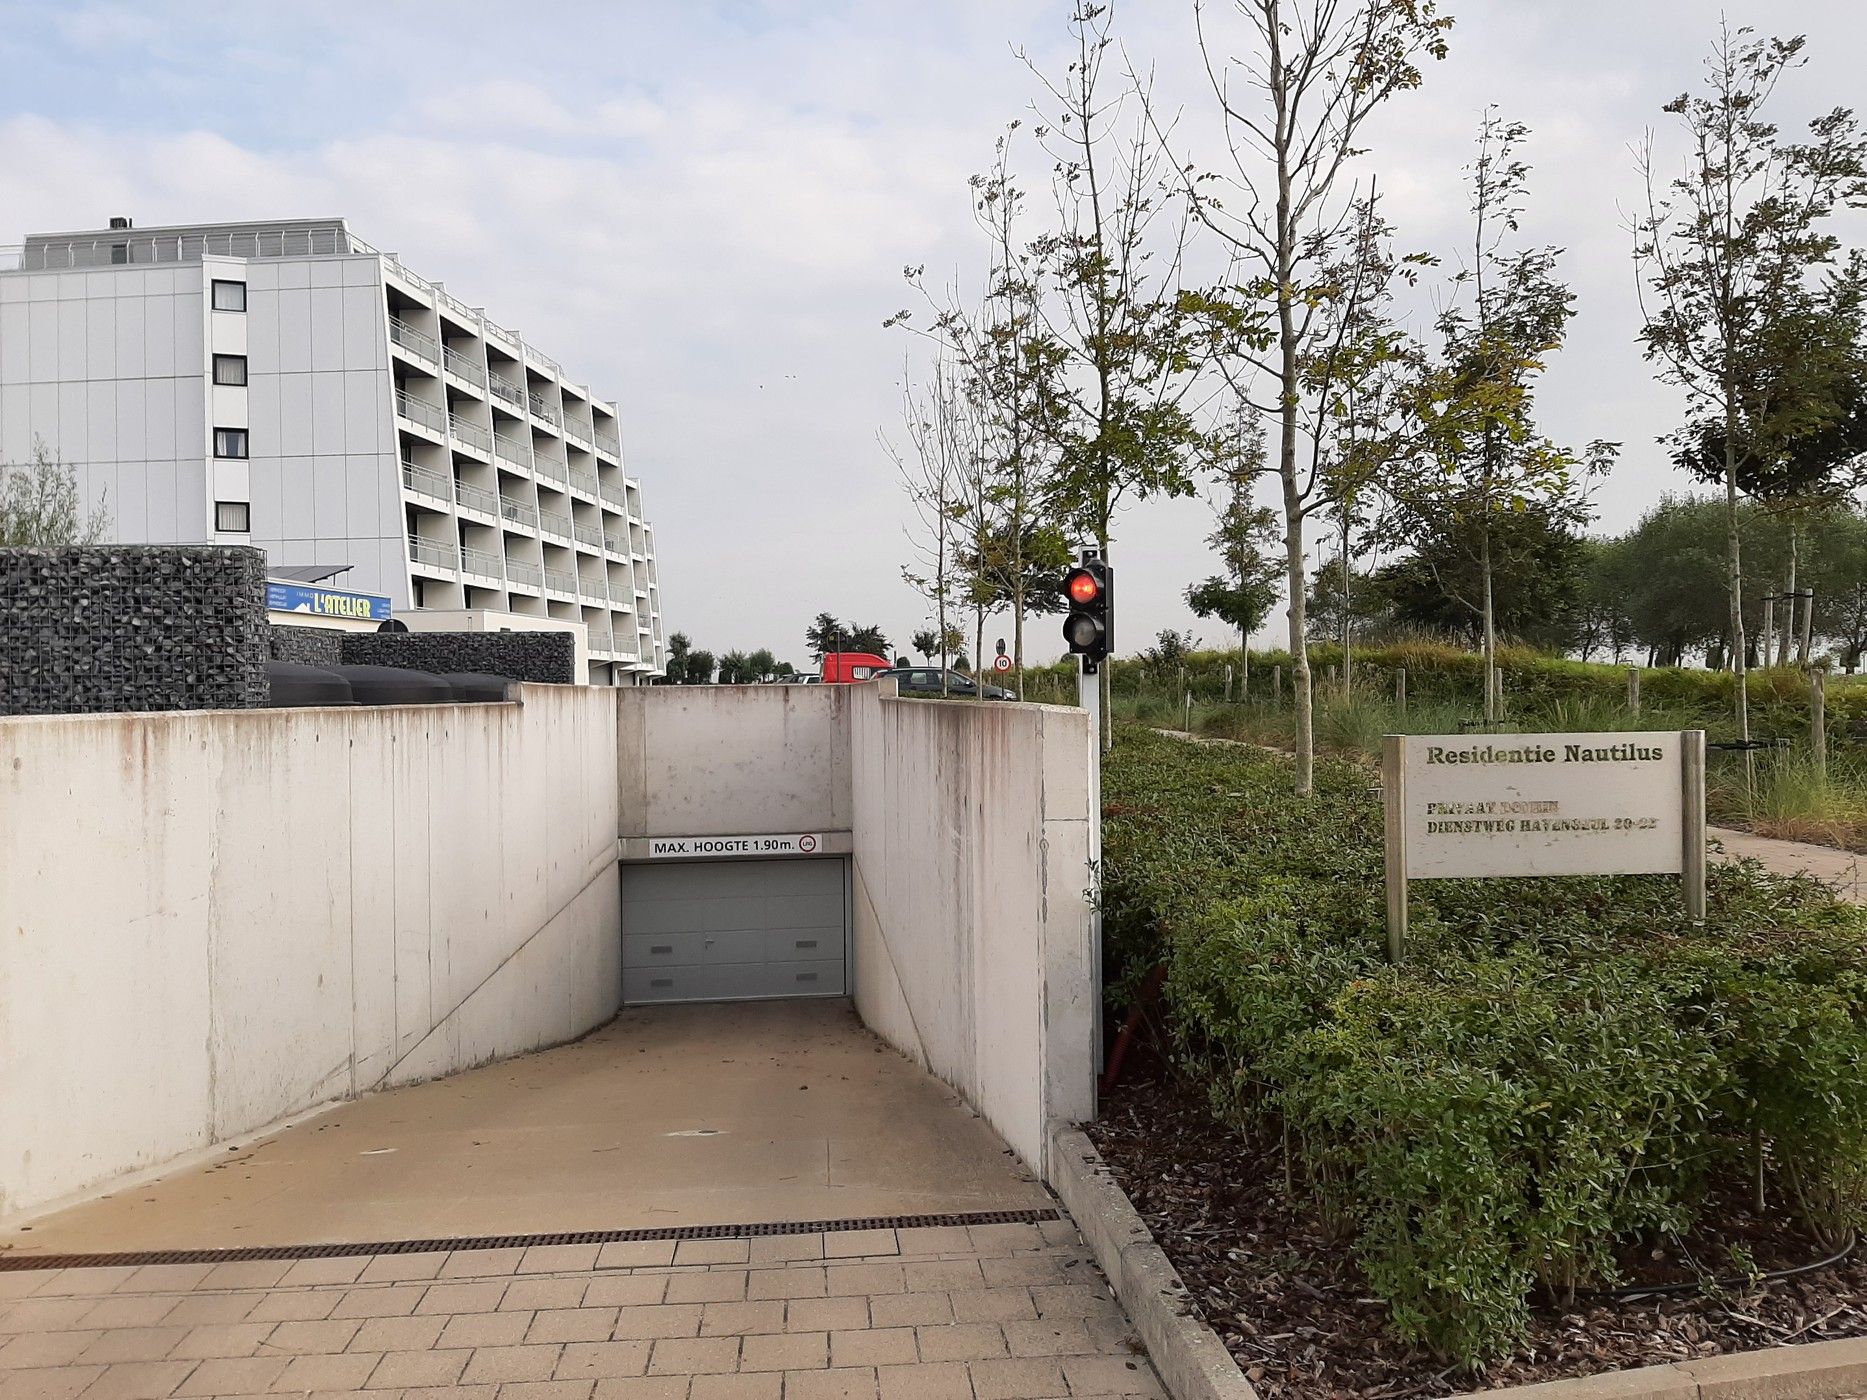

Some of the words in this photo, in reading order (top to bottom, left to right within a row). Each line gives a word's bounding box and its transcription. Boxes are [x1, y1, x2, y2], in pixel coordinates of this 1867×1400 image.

[314, 592, 371, 618] L'ATELIER
[999, 659, 1007, 667] 10
[1426, 745, 1556, 764] Residentie
[1564, 743, 1663, 762] Nautilus
[1427, 820, 1515, 833] DIENSTWEG
[654, 842, 690, 853] MAX.
[694, 840, 749, 852] HOOGTE
